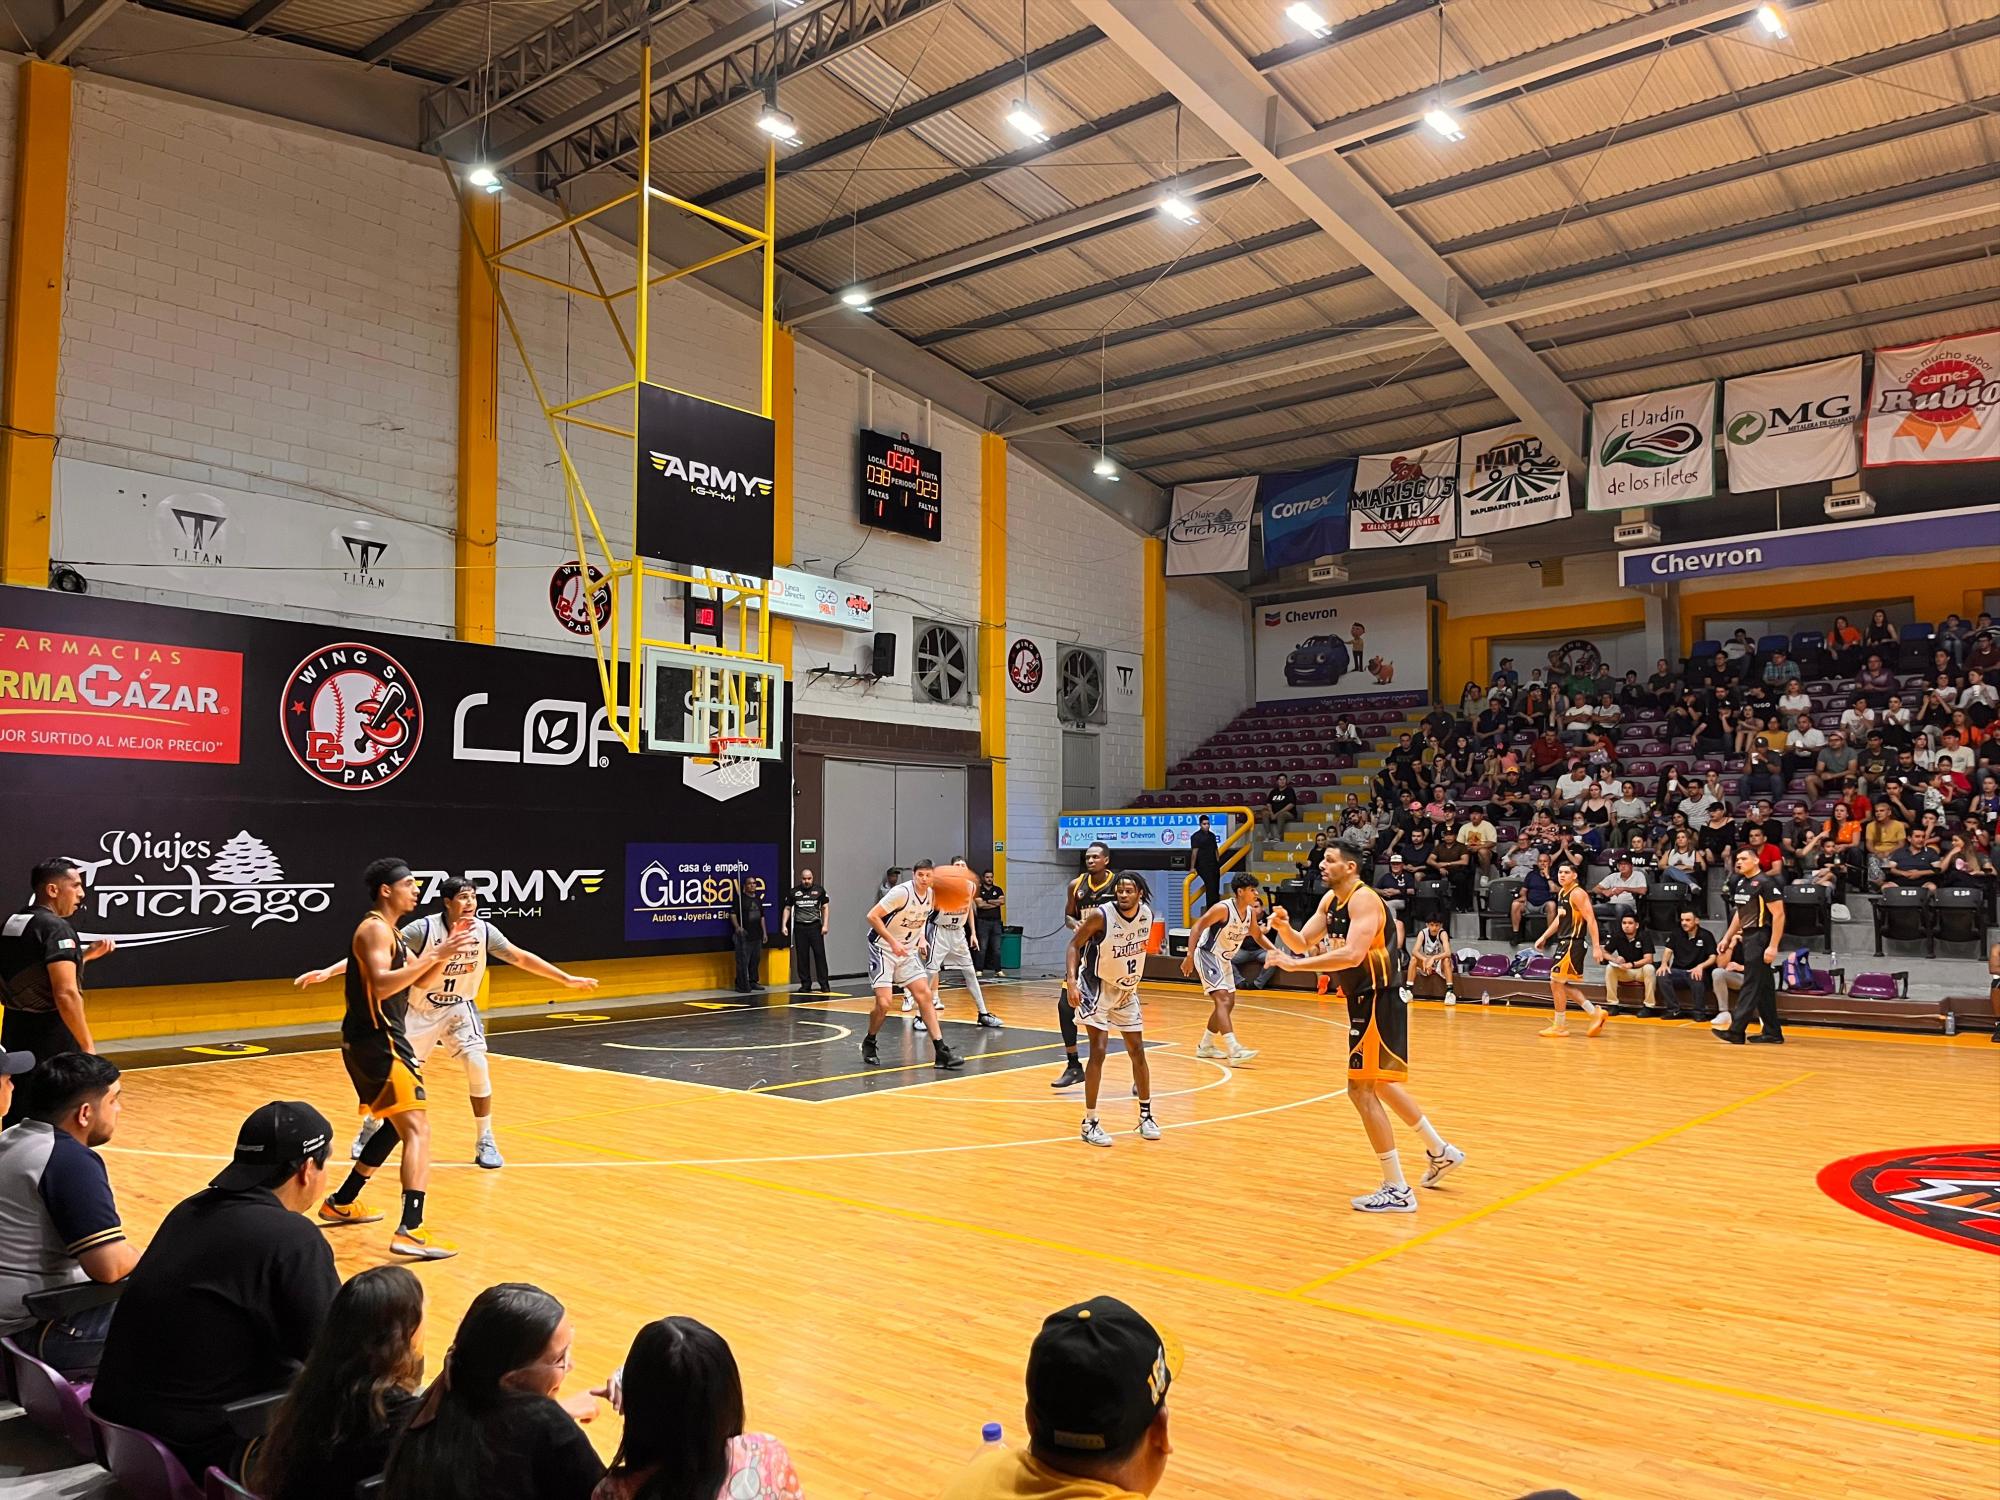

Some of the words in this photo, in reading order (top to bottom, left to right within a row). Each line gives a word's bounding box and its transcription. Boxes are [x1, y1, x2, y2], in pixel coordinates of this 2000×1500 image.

[1921, 351, 1962, 368] mucho
[1920, 370, 1969, 385] carnes
[1879, 379, 2000, 413] Rubio
[1621, 409, 1635, 429] El
[1768, 395, 1851, 429] MG
[893, 443, 915, 455] TIEMPO
[868, 454, 886, 466] LOCAL
[1476, 445, 1521, 474] IVAN
[650, 451, 773, 496] ARMY
[891, 477, 917, 489] PERIODO
[921, 470, 938, 481] VISITA
[1608, 477, 1625, 496] de
[1629, 473, 1649, 492] los
[1654, 467, 1698, 488] Filetes
[867, 488, 890, 500] FALTAS
[918, 501, 939, 513] FALTAS
[1384, 506, 1403, 521] LA
[1408, 503, 1421, 517] 19
[173, 547, 223, 565] TITAN
[1651, 547, 1762, 575] Chevron
[344, 572, 385, 588] TITAN
[1285, 608, 1337, 623] Chevron
[31, 730, 93, 746] SURTIDO
[97, 735, 114, 747] AL
[118, 736, 163, 749] MEJOR
[343, 750, 404, 783] PARK
[1125, 816, 1147, 826] POR
[1151, 815, 1165, 825] TU
[1130, 831, 1156, 839] Chevron
[99, 830, 211, 872] Viajes
[678, 863, 700, 873] casa
[702, 863, 712, 872] de
[93, 864, 331, 931] richago
[652, 913, 677, 923] Autos
[1126, 959, 1137, 975] 12
[443, 978, 457, 993] 11
